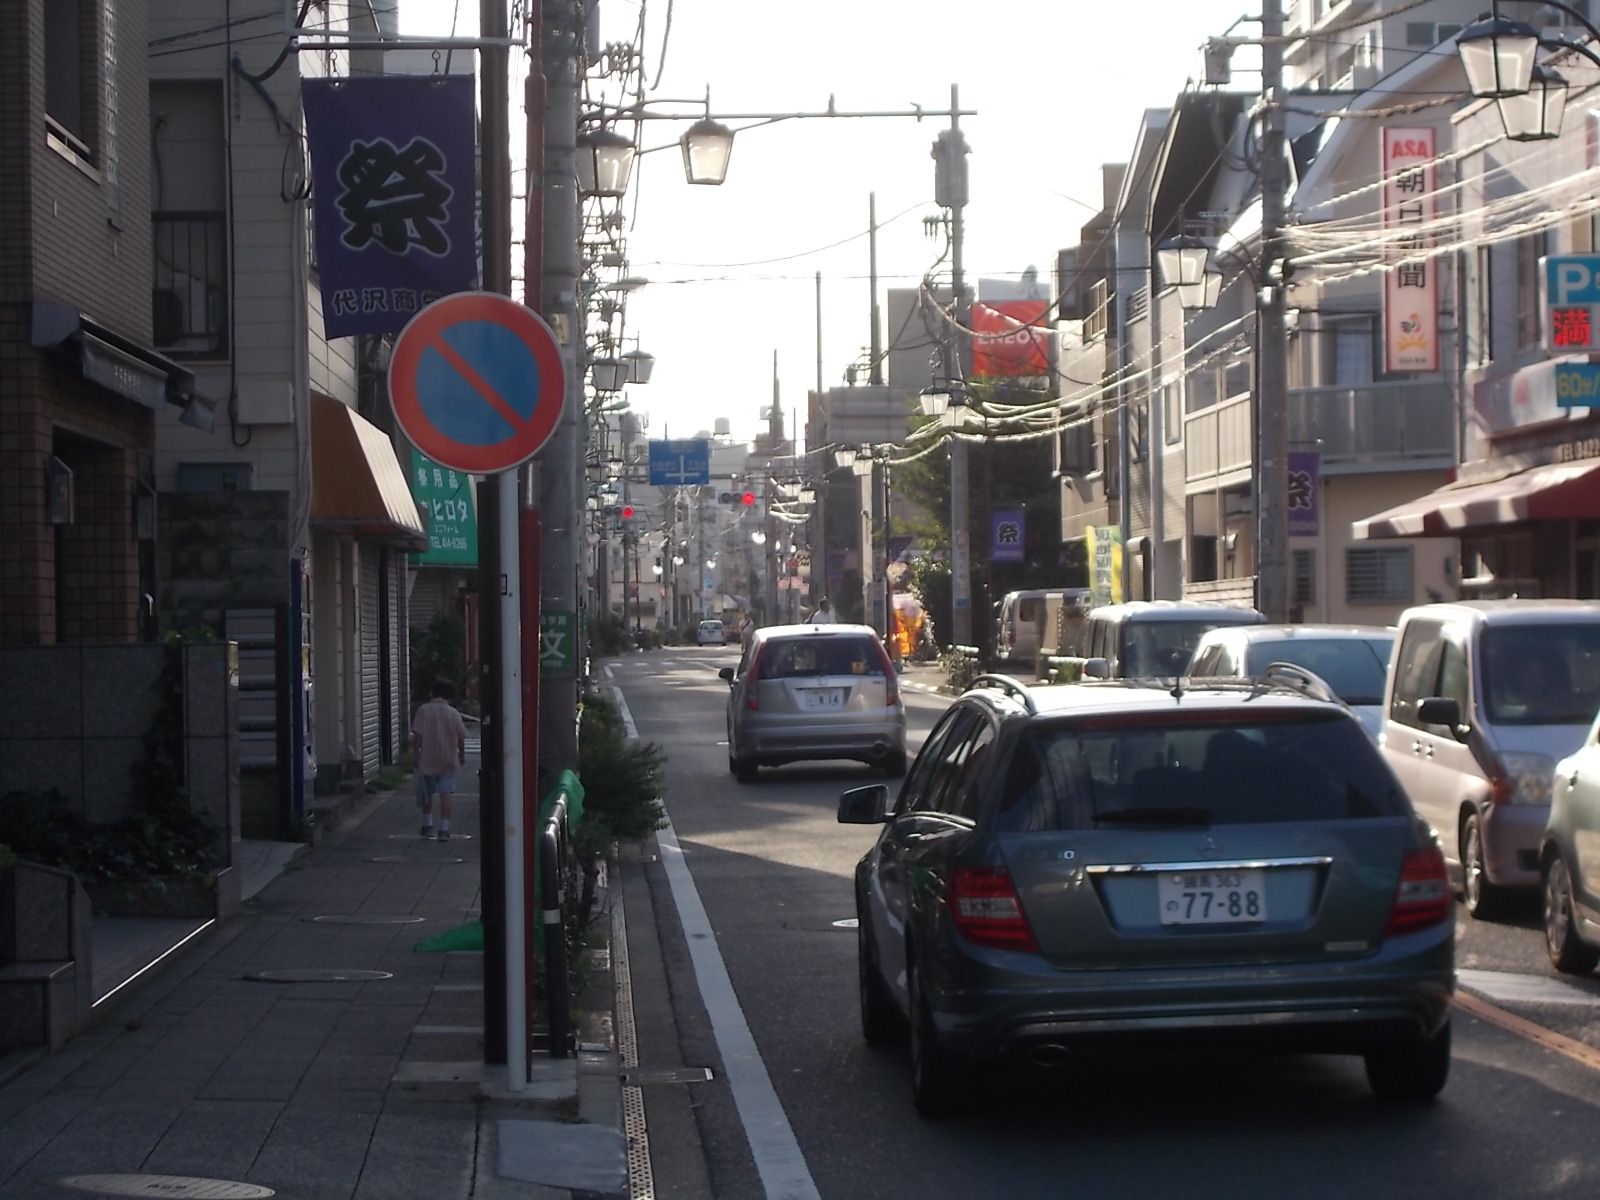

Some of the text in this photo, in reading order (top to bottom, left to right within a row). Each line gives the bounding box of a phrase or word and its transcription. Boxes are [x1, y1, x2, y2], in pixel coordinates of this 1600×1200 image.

[1392, 140, 1428, 158] ASA
[335, 136, 454, 257] 祭
[977, 328, 1042, 344] ENEOS
[1553, 308, 1592, 346] 満
[998, 521, 1021, 545] 祭
[1182, 890, 1260, 919] 77-88
